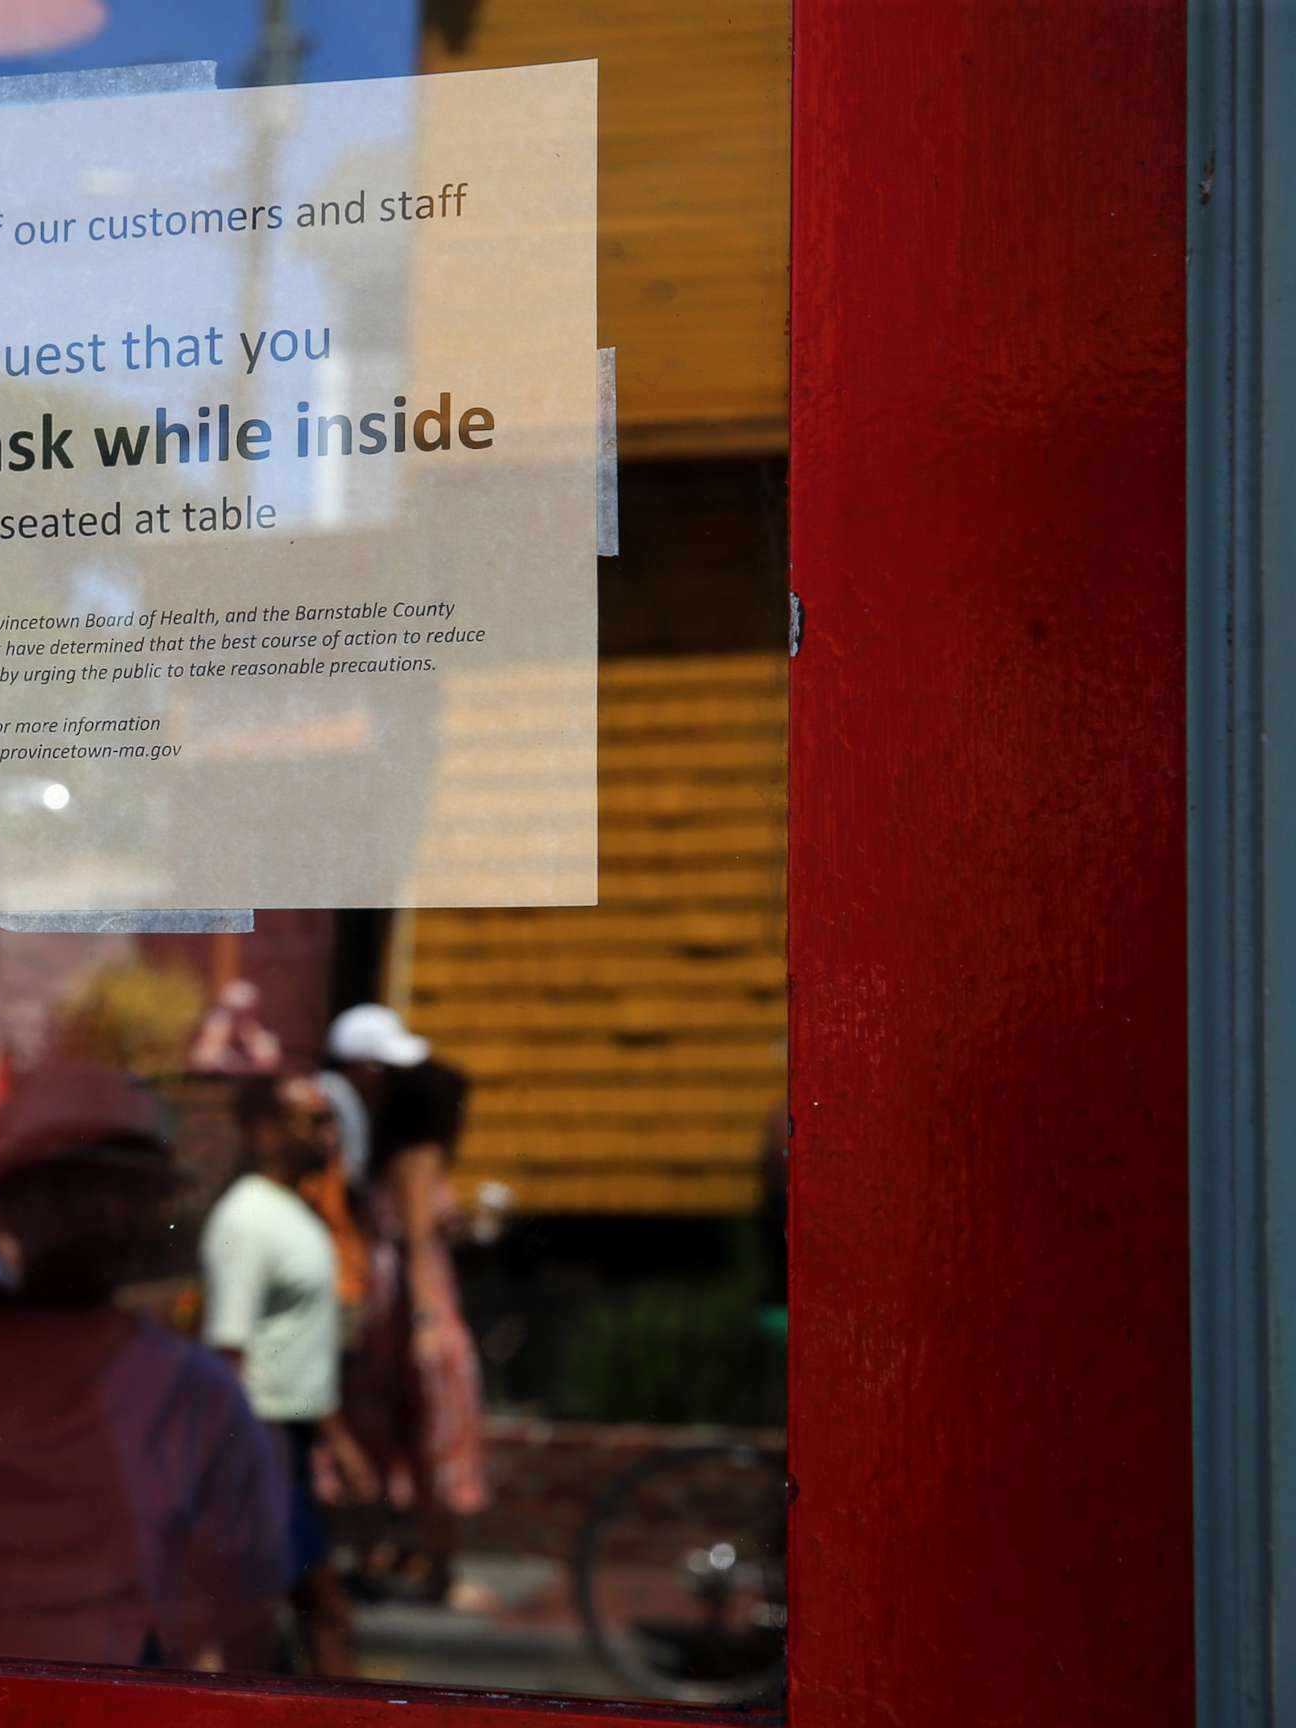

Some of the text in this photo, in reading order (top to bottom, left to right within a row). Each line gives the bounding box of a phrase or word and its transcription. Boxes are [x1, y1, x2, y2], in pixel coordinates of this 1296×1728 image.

[15, 219, 76, 245] our
[89, 206, 282, 240] customers
[297, 190, 364, 227] and
[380, 183, 468, 221] staff
[122, 324, 223, 370] that
[240, 328, 332, 374] you
[94, 404, 271, 467] while
[297, 392, 495, 457] inside
[0, 502, 120, 539] seated
[136, 504, 170, 534] at
[182, 496, 275, 532] table
[85, 611, 134, 628] Board
[139, 610, 157, 629] of
[161, 609, 219, 626] Health,
[226, 606, 257, 623] and
[263, 606, 290, 621] the
[296, 602, 387, 620] Barnstable
[393, 602, 455, 619] County
[6, 640, 45, 656] have
[50, 637, 144, 654] determined
[150, 636, 184, 651] that
[189, 635, 216, 650] the
[221, 634, 257, 649] best
[262, 635, 317, 648] course
[322, 630, 341, 649] of
[345, 630, 397, 646] action
[403, 630, 421, 644] to
[427, 627, 485, 643] reduce
[0, 667, 18, 685] by
[24, 669, 76, 684] urging
[81, 665, 108, 680] the
[112, 663, 162, 682] public
[168, 664, 184, 677] to
[190, 661, 225, 676] take
[231, 658, 325, 676] reasonable
[329, 656, 435, 677] precautions.
[15, 722, 58, 733] more
[63, 716, 160, 736] information
[0, 744, 181, 762] provincetown-ma.gov
